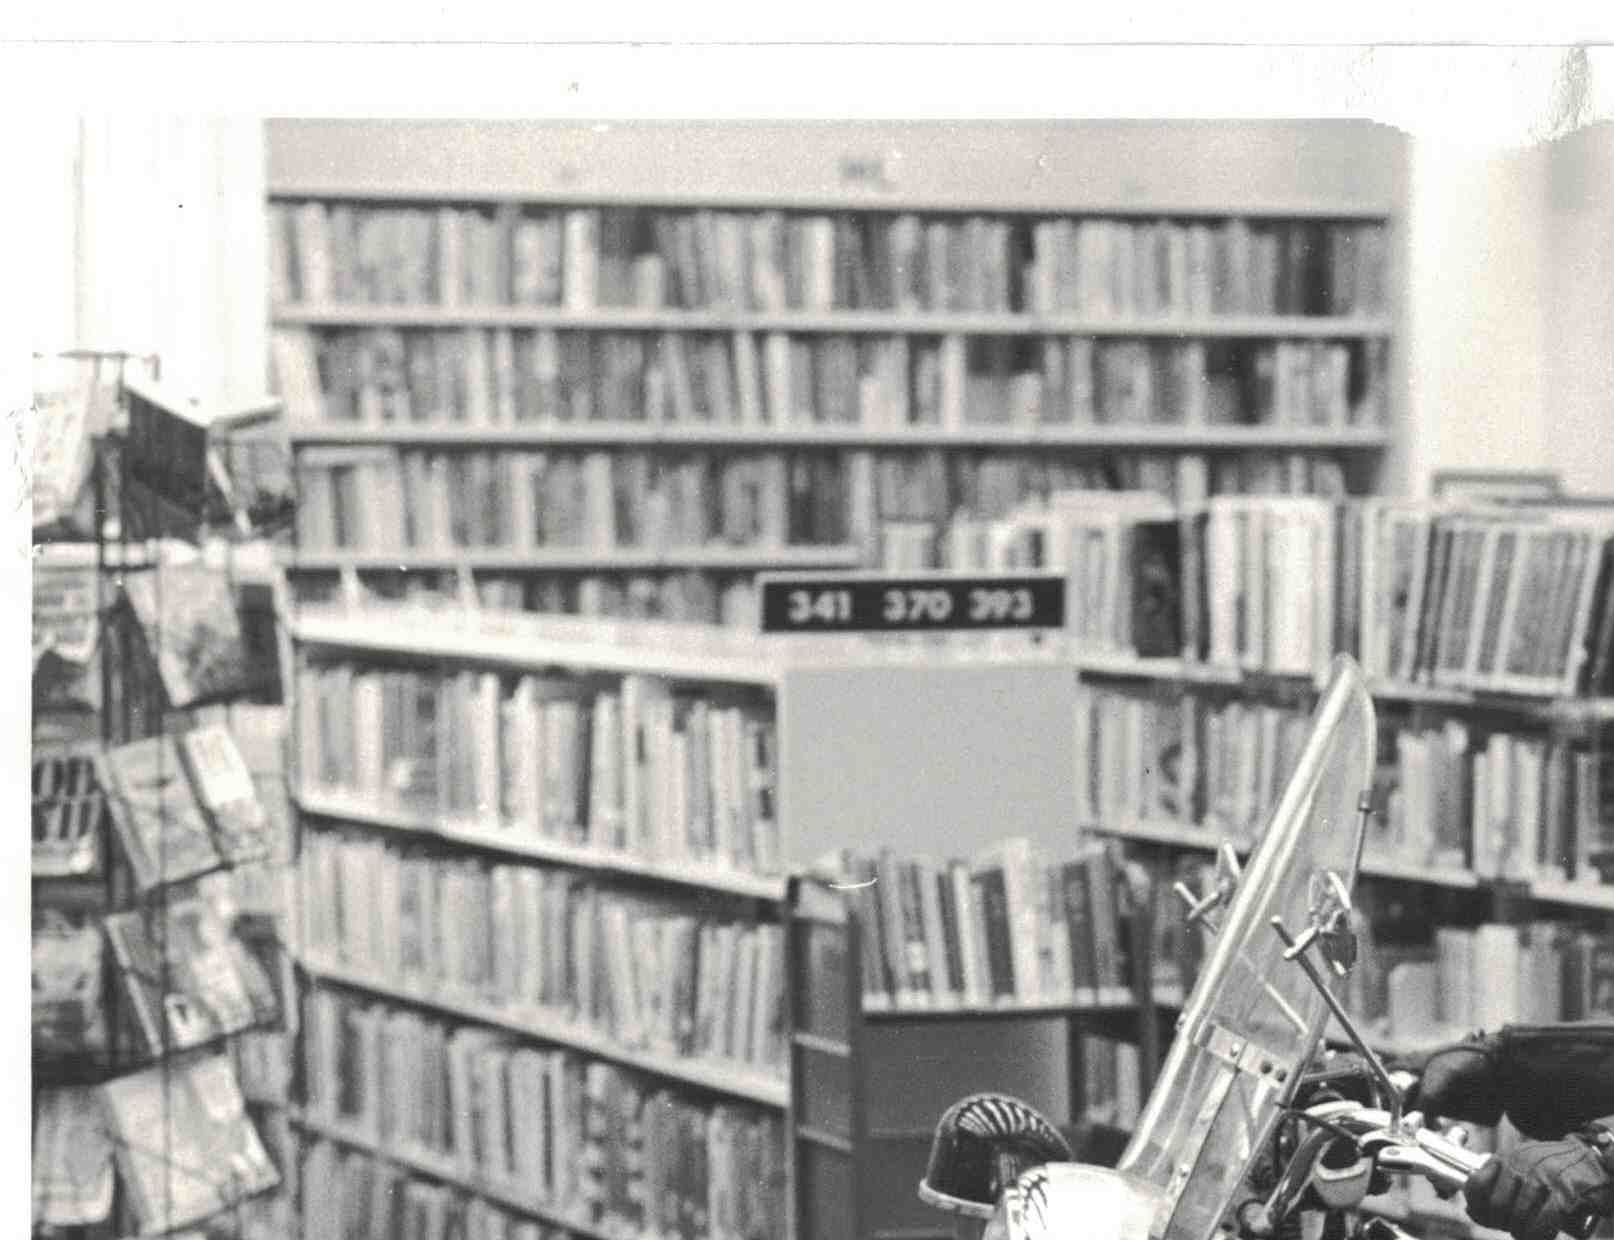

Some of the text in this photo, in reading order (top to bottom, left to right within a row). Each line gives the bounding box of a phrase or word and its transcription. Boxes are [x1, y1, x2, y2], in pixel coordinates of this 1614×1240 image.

[788, 588, 1033, 621] 341 370 393
